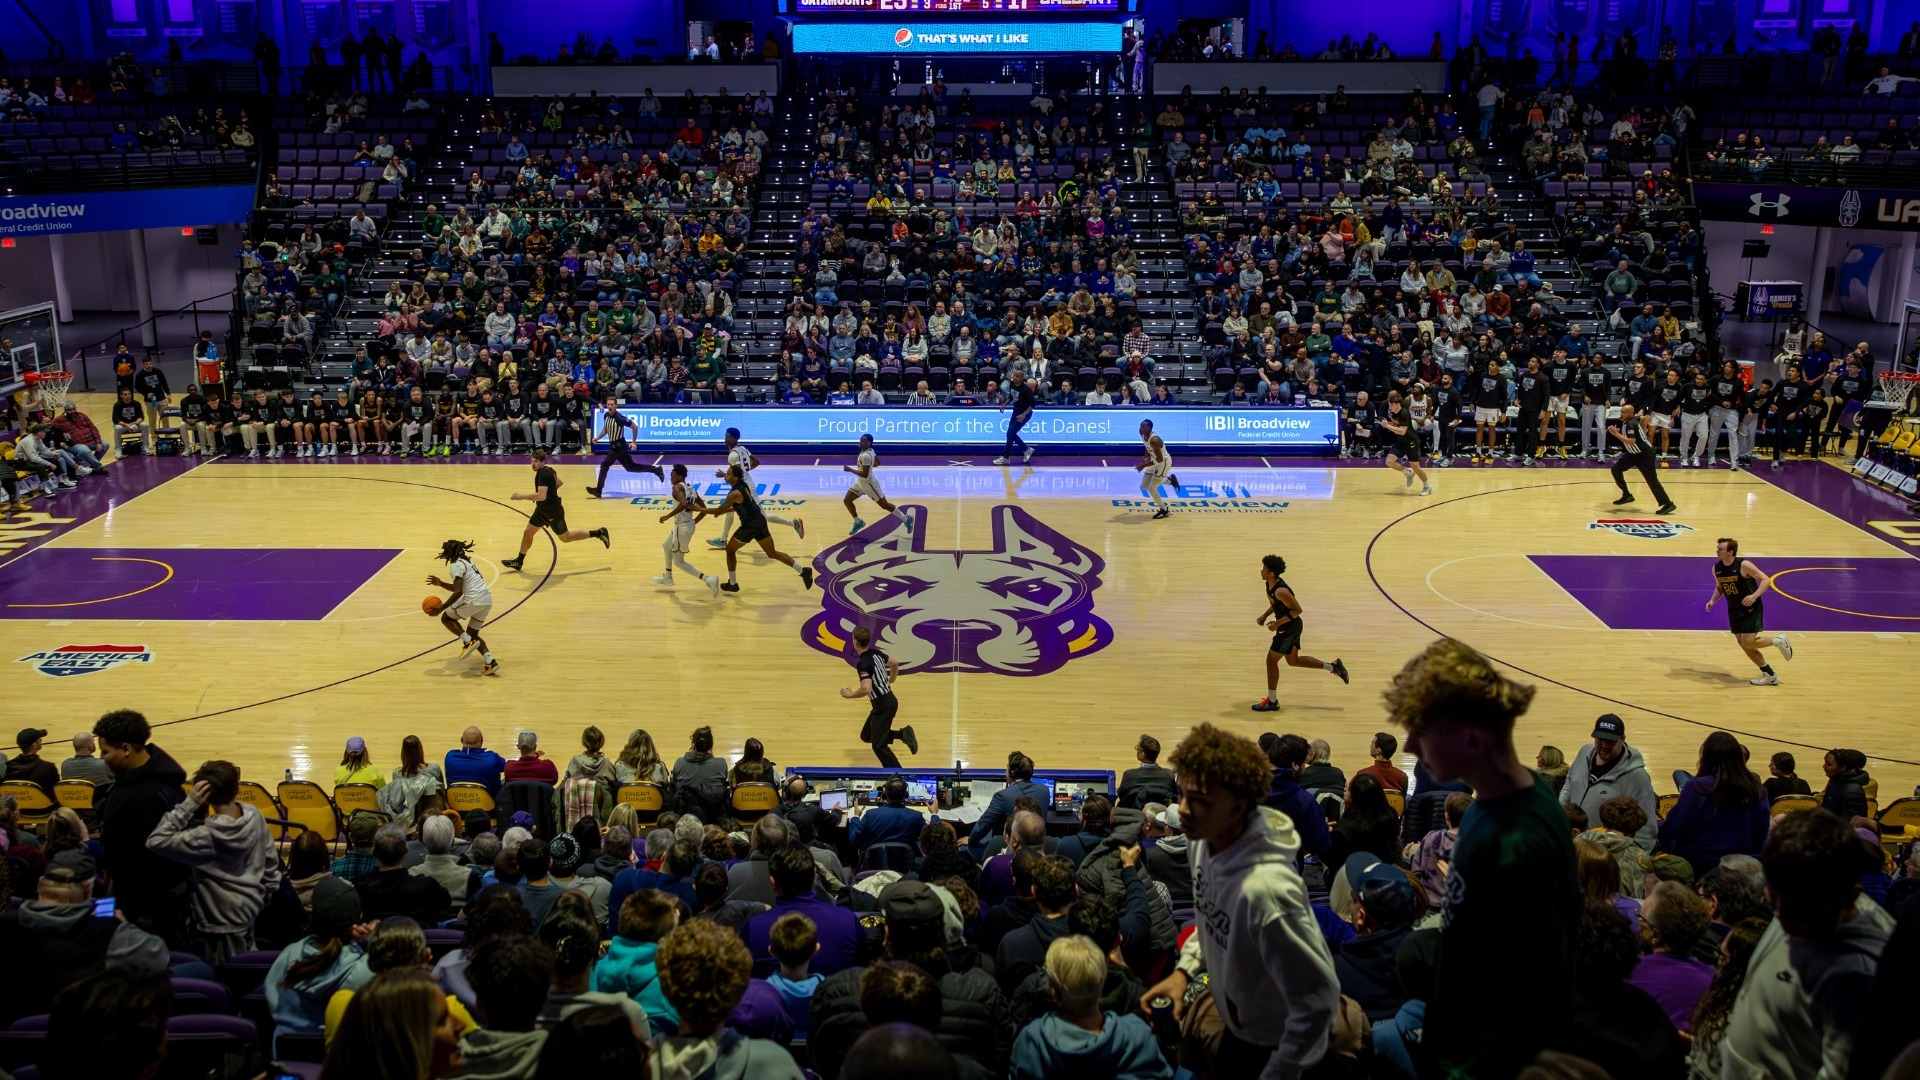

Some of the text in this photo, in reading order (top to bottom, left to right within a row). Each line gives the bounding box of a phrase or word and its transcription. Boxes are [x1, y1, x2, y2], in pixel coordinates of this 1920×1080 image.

[917, 34, 957, 44] THAT'S
[959, 34, 993, 44] WHAT
[1003, 34, 1029, 44] LIKE
[0, 203, 85, 221] oadview
[18, 223, 45, 232] Credit
[46, 222, 73, 231] Union
[650, 416, 721, 428] Broadview
[818, 417, 1111, 434] Proud Partner of the Geat Danes!
[1238, 417, 1310, 429] Broadview
[19, 652, 151, 662] AMERICA
